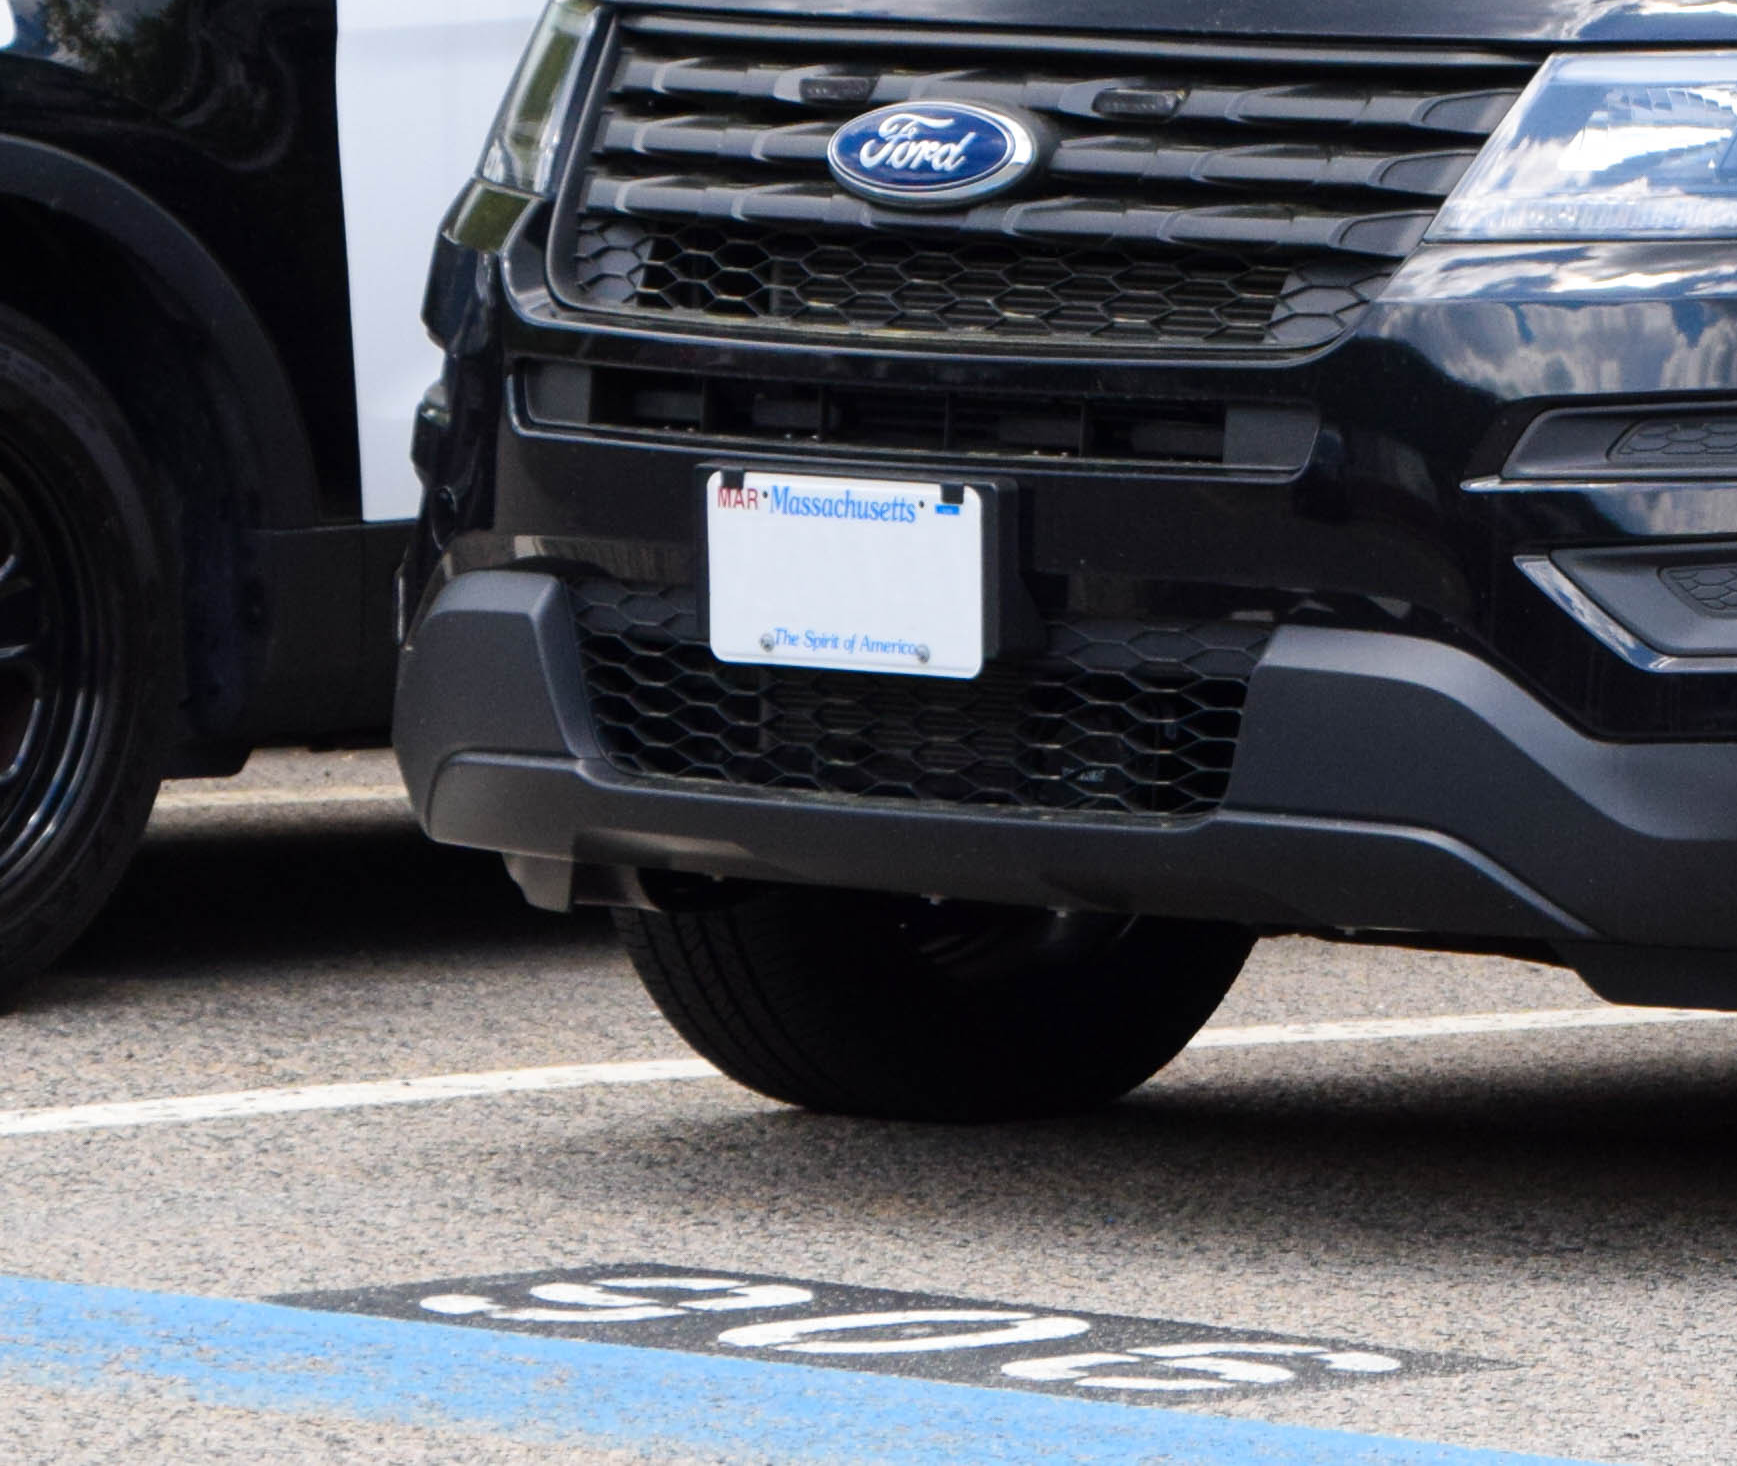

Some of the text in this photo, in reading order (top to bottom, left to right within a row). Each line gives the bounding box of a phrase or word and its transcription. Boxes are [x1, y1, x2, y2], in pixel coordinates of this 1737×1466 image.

[859, 112, 977, 172] Ford
[717, 484, 917, 523] MAR Massachusetts
[774, 627, 800, 646] The
[804, 629, 840, 651] Spirit
[844, 634, 857, 654] of
[418, 1276, 1403, 1391] 906
